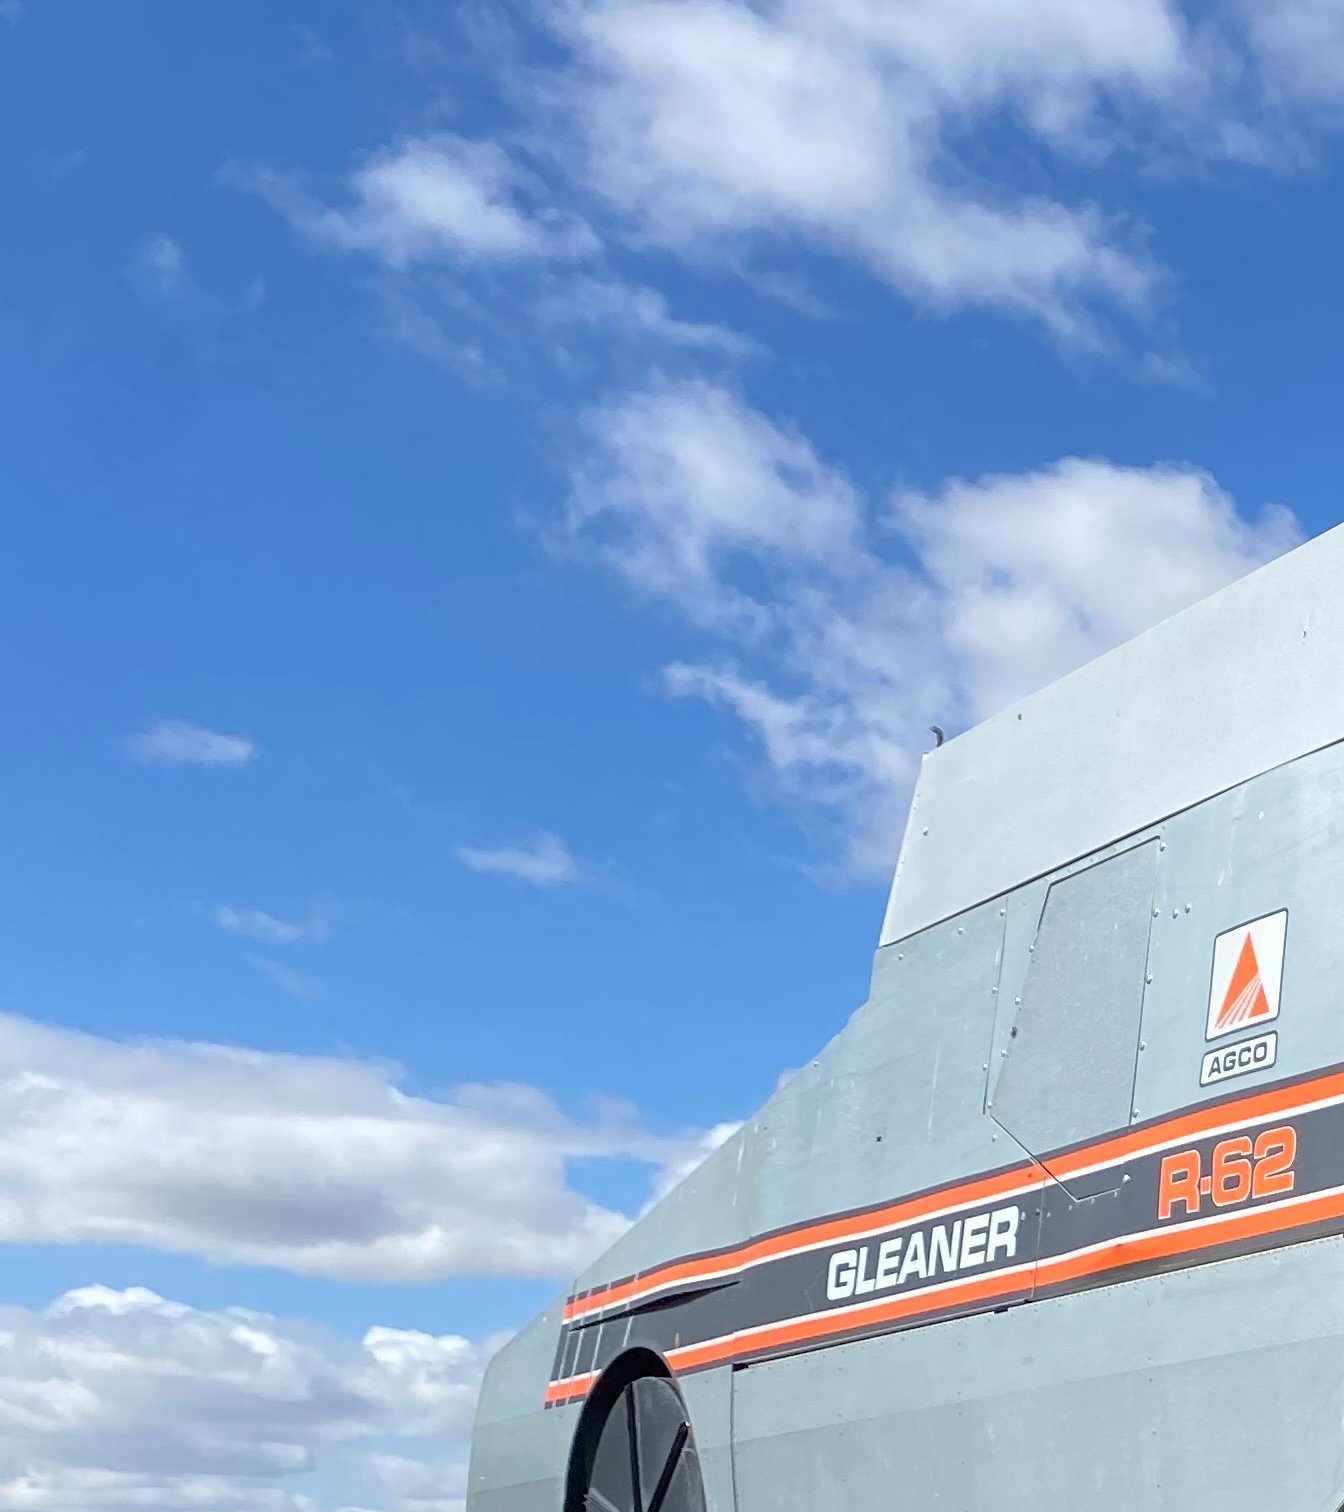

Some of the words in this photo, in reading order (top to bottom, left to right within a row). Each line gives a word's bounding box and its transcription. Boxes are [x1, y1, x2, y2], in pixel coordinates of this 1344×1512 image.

[1207, 1041, 1268, 1078] AGCO
[1157, 1125, 1297, 1220] R-62
[826, 1204, 1021, 1301] GLEANER
